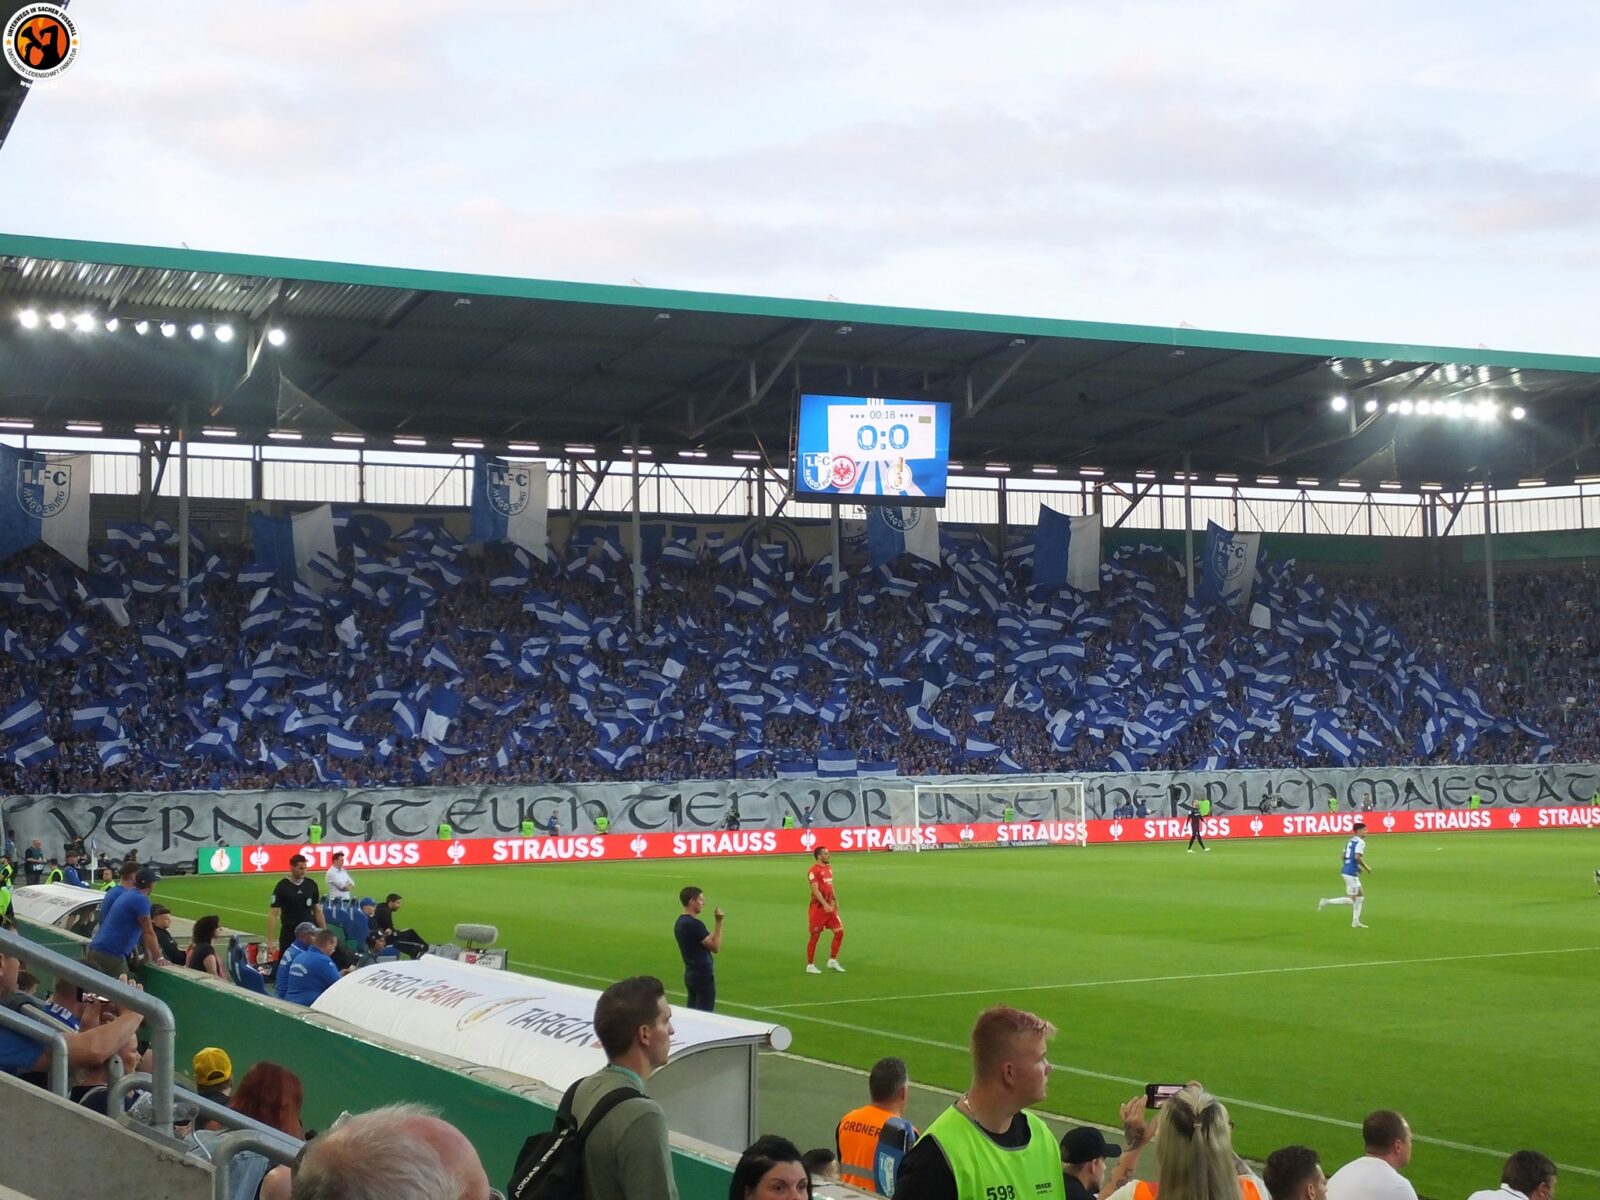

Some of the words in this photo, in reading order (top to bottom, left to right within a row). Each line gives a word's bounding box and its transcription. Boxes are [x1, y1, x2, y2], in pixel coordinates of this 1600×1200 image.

[869, 410, 896, 420] 00:18
[856, 424, 910, 451] 0:0
[23, 487, 65, 514] MAGDEBURG
[491, 487, 527, 512] MAGDEBURG
[48, 799, 432, 852] VERNEIGT
[779, 787, 893, 828] VOR
[299, 842, 420, 868] STRAUSS
[492, 837, 606, 861] STRAUSS
[672, 831, 777, 855] STRAUSS
[840, 826, 937, 849] STRAUSS
[997, 822, 1089, 843] STRAUSS
[1414, 809, 1491, 829] STRAUSS
[513, 1165, 541, 1199] ADIDAS
